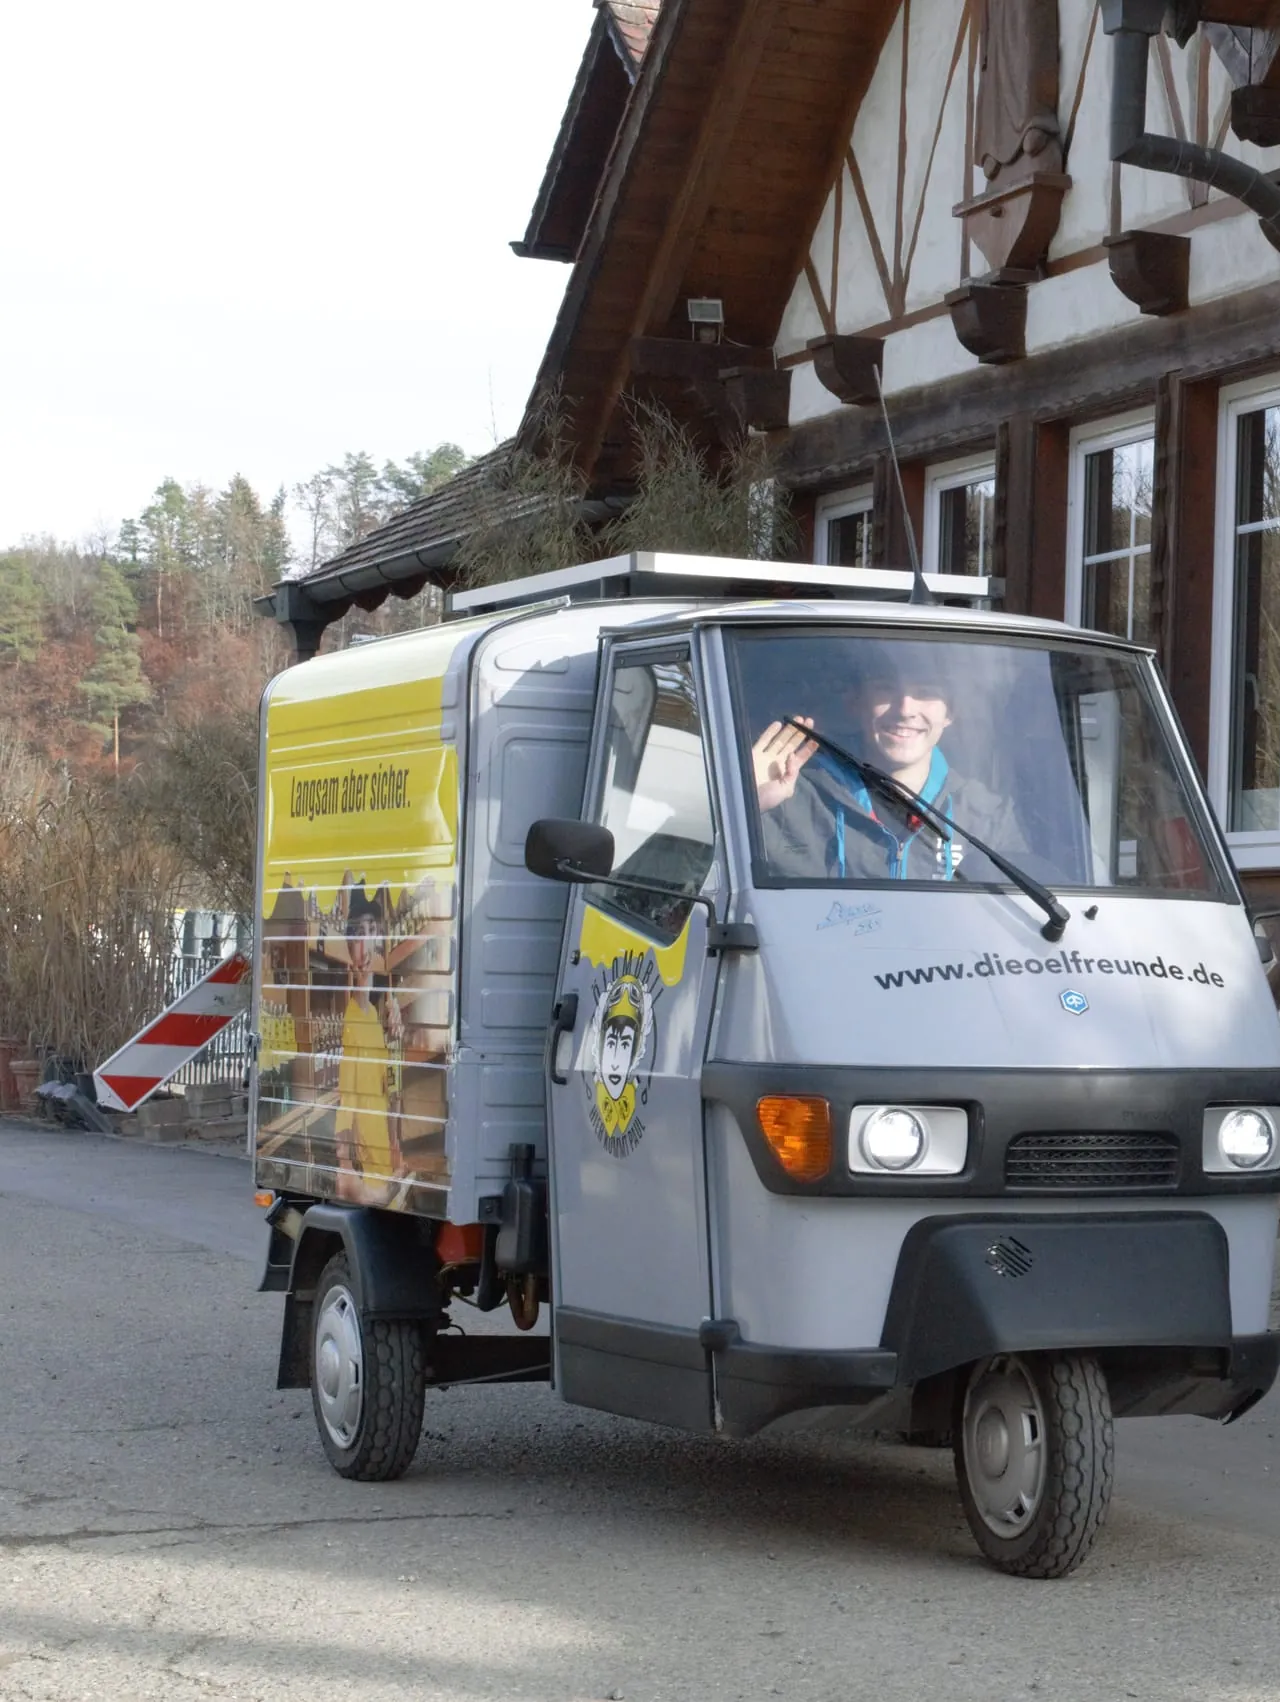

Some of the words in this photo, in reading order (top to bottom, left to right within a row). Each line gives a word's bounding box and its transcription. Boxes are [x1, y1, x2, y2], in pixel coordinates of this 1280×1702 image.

[290, 775, 340, 822] Langsam
[341, 768, 369, 814] aber
[370, 763, 411, 812] sicher.
[875, 950, 1226, 990] www.dieoelfreunde.de
[627, 1116, 646, 1152] PAUL
